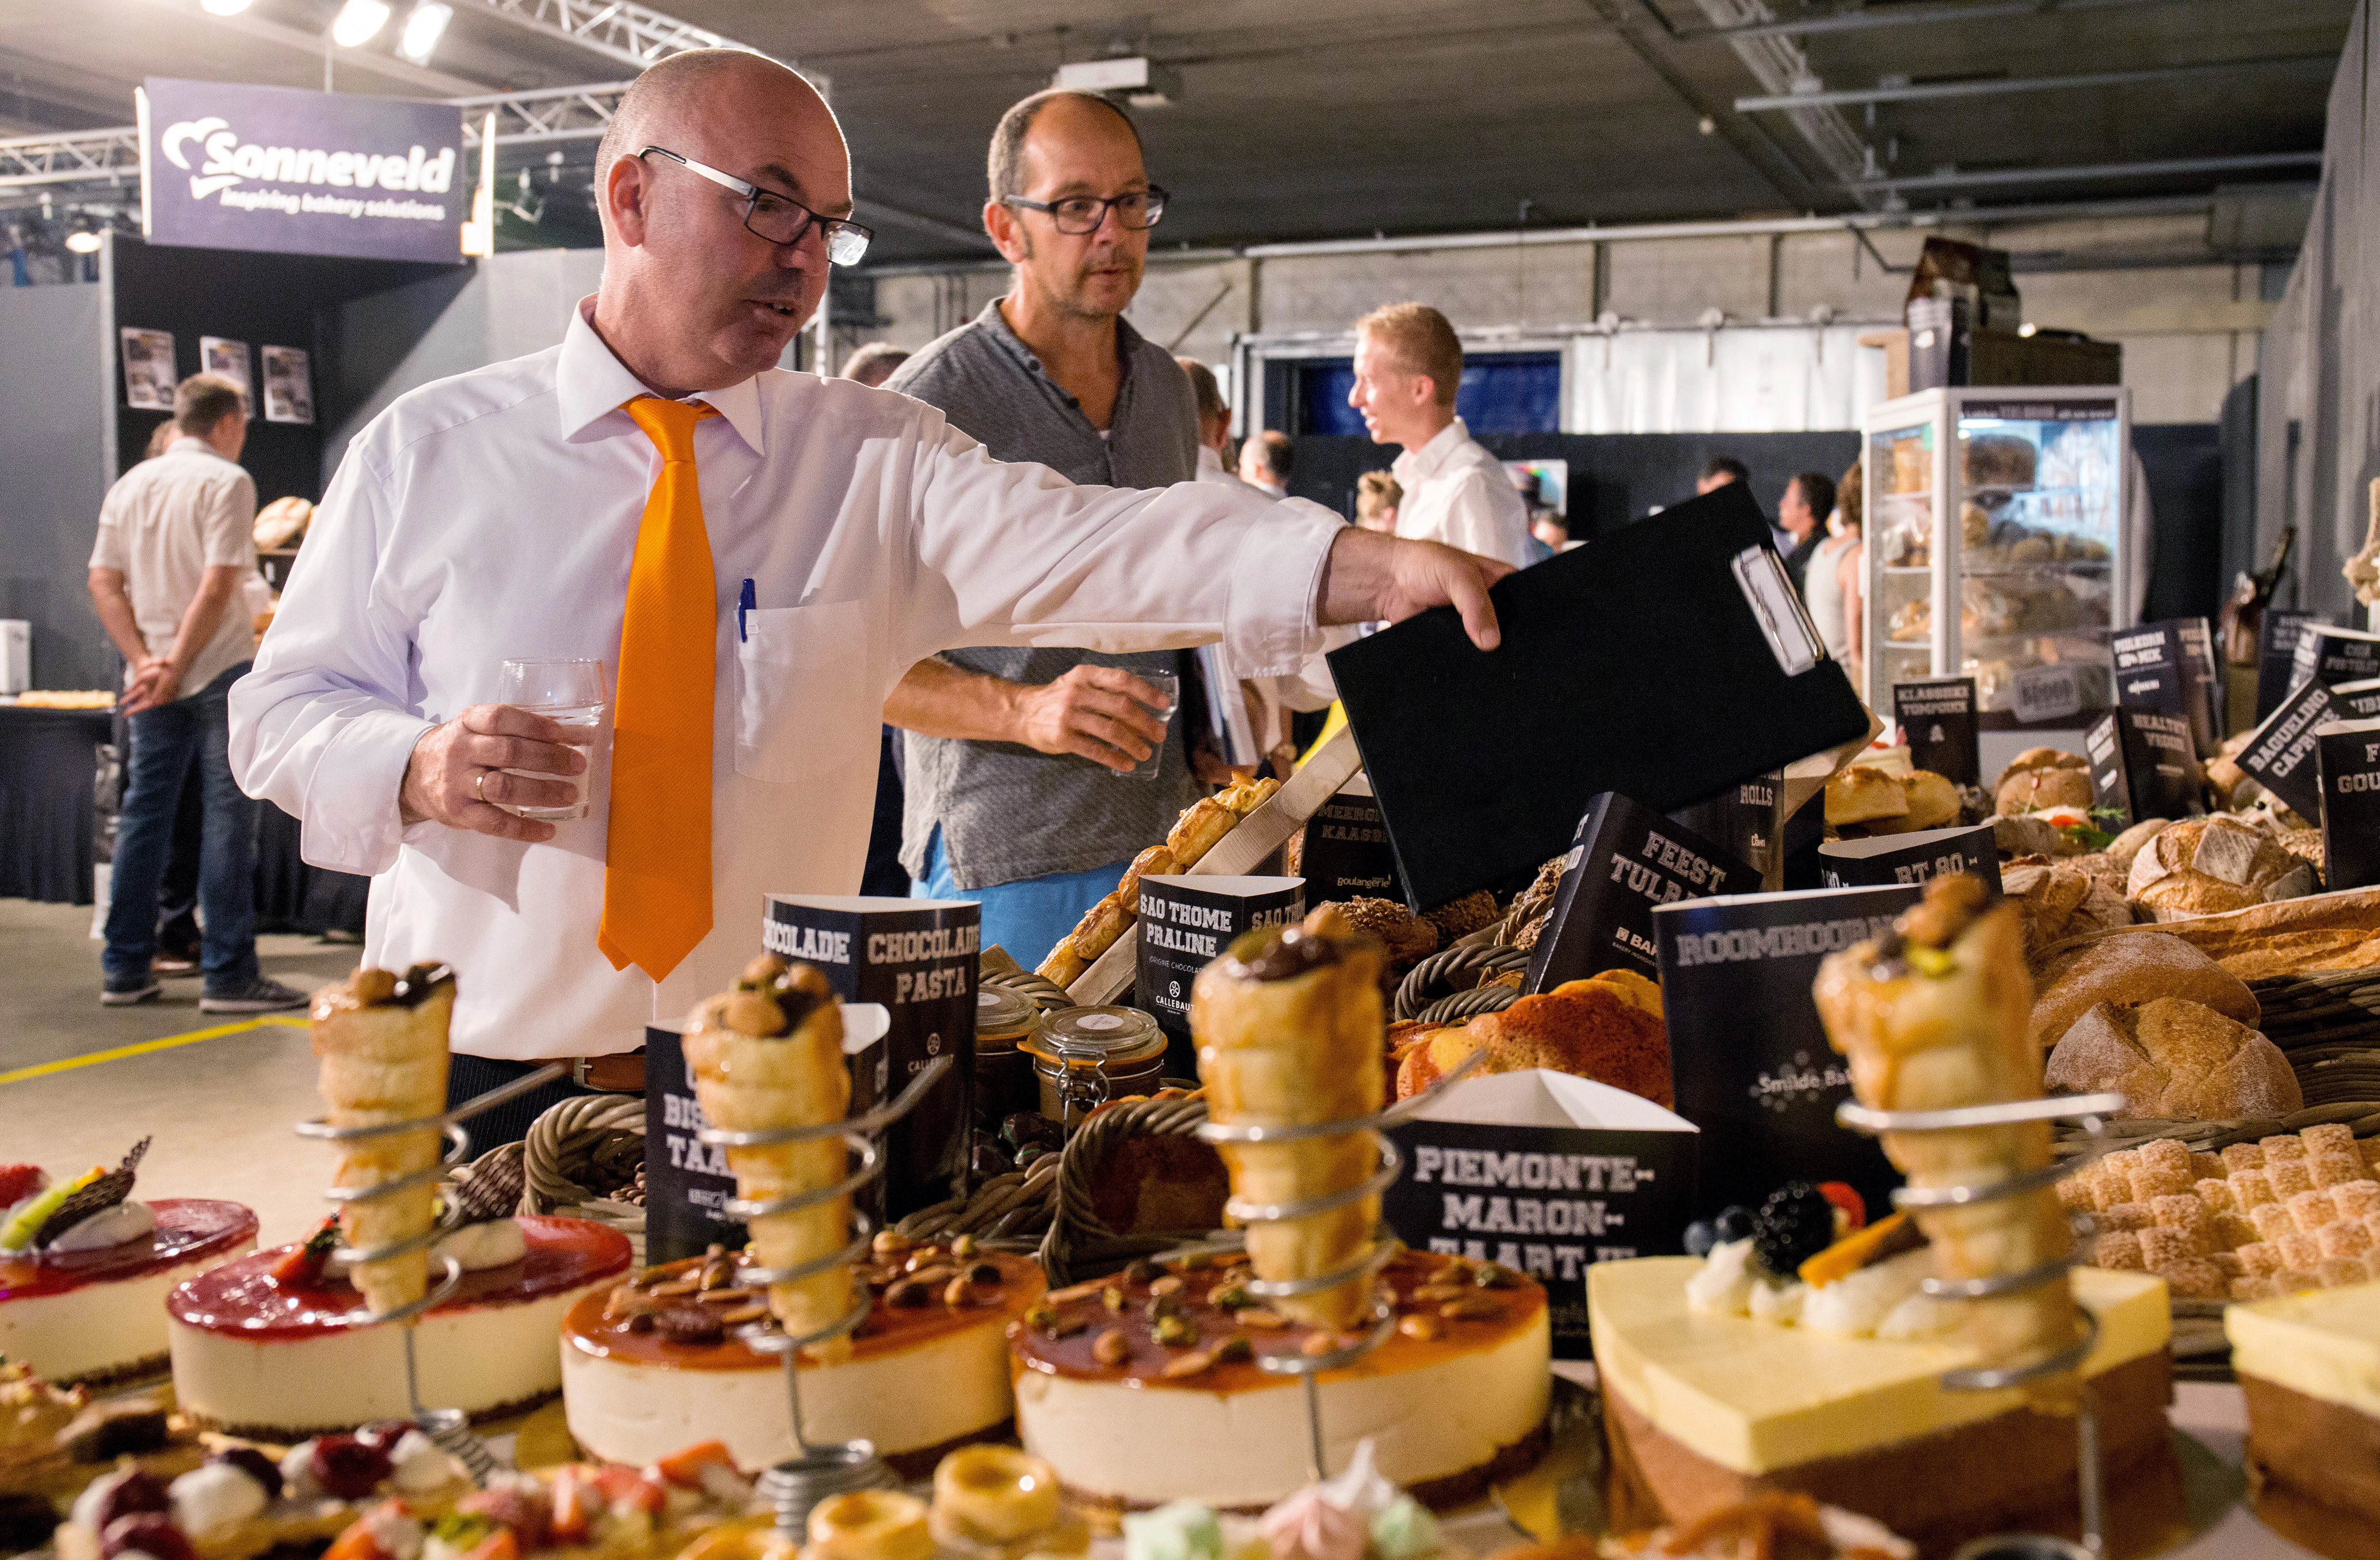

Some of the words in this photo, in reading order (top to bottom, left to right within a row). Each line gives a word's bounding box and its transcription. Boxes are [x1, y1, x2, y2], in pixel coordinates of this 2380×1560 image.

[201, 131, 456, 193] Sonneveld
[300, 192, 365, 219] bakery
[364, 198, 445, 221] solutions
[2247, 689, 2329, 773] BAGUELINO
[1740, 784, 1773, 806] ROLLS
[1642, 830, 1727, 893] FEEST
[1894, 861, 1929, 885] BT
[1337, 876, 1390, 889] Boulangerie
[1140, 893, 1166, 919] SAO
[1168, 901, 1232, 933] THOME
[1146, 922, 1217, 958] PRALINE
[894, 966, 967, 1005] PASTA
[1156, 995, 1195, 1013] CALLEBAUT
[1758, 1071, 1821, 1094] Smilde
[666, 1133, 736, 1178] TAA
[1414, 1146, 1655, 1193] PIEMONTE-
[1442, 1193, 1625, 1236] MARON-
